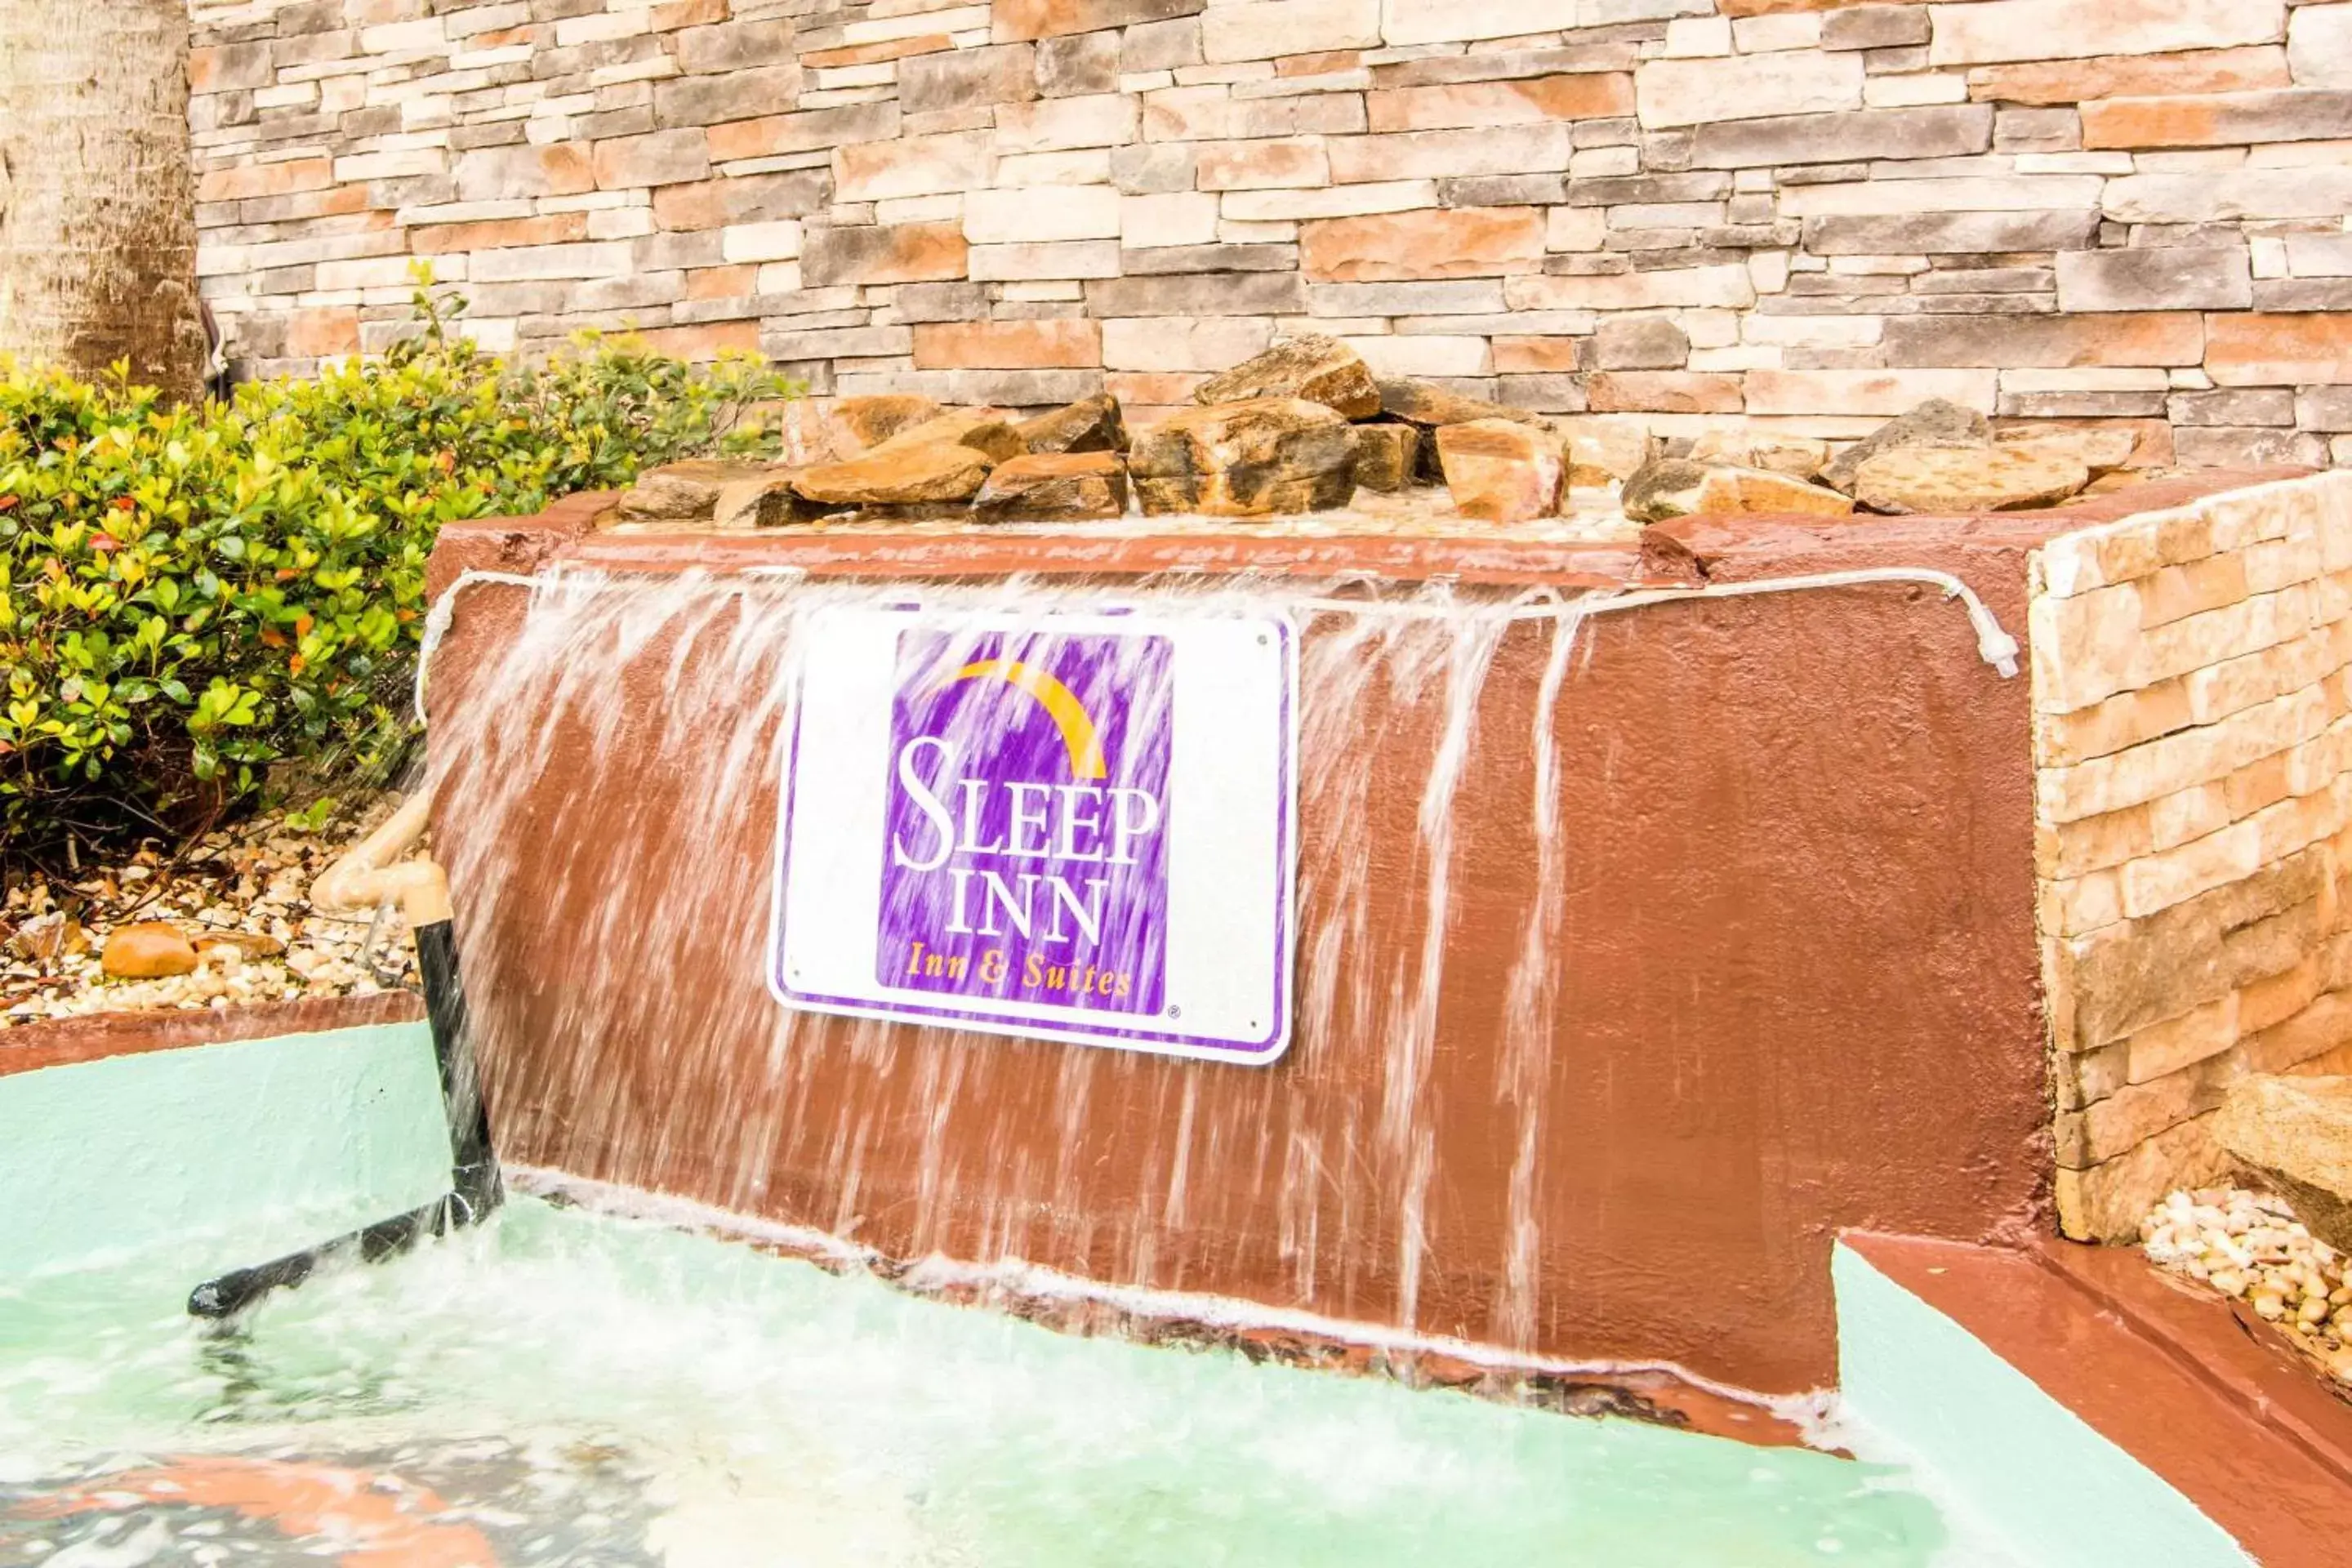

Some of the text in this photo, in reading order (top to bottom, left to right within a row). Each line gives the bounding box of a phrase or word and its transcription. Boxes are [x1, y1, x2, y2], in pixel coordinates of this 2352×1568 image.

[893, 735, 1159, 871] SLEEP
[945, 869, 1108, 946] INN
[906, 941, 1132, 997] Inn & Suites
